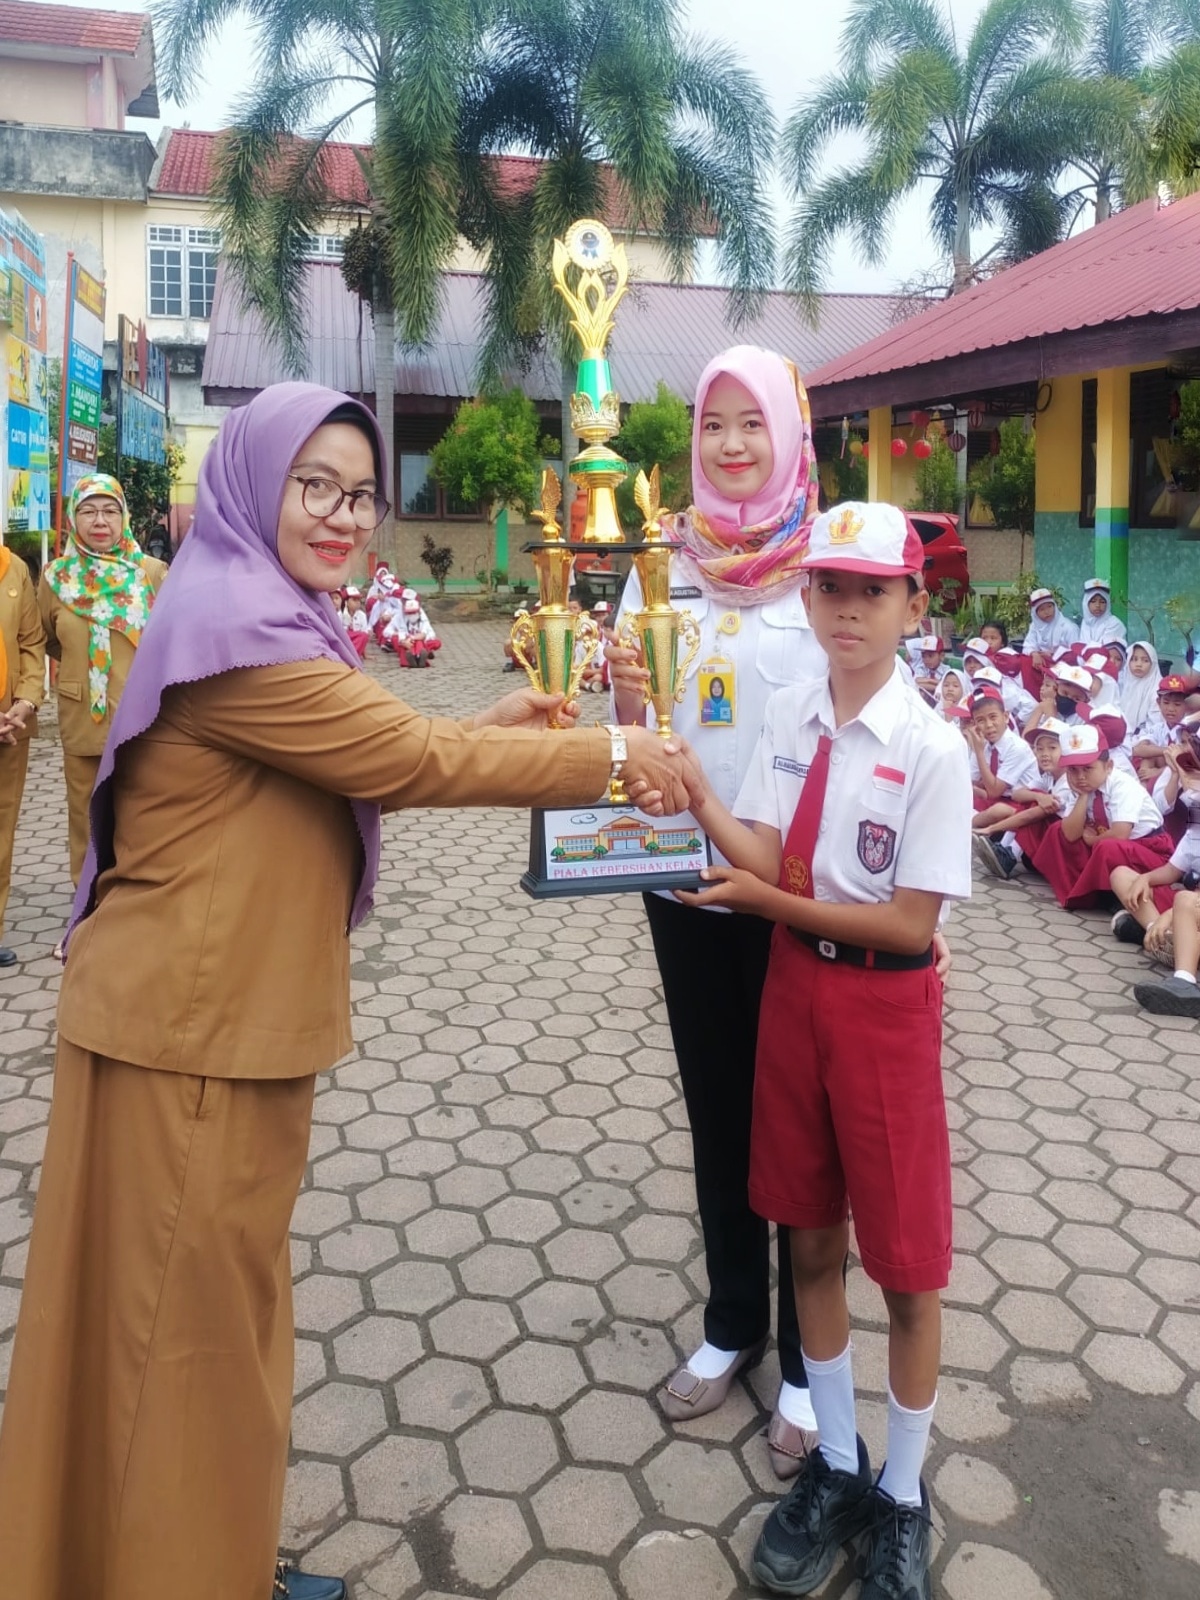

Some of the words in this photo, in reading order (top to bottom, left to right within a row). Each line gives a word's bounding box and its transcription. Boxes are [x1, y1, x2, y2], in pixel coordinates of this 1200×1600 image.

[553, 867, 589, 879] PIALA
[592, 862, 663, 877] KEBERSIHAN
[665, 859, 703, 872] KELAS
